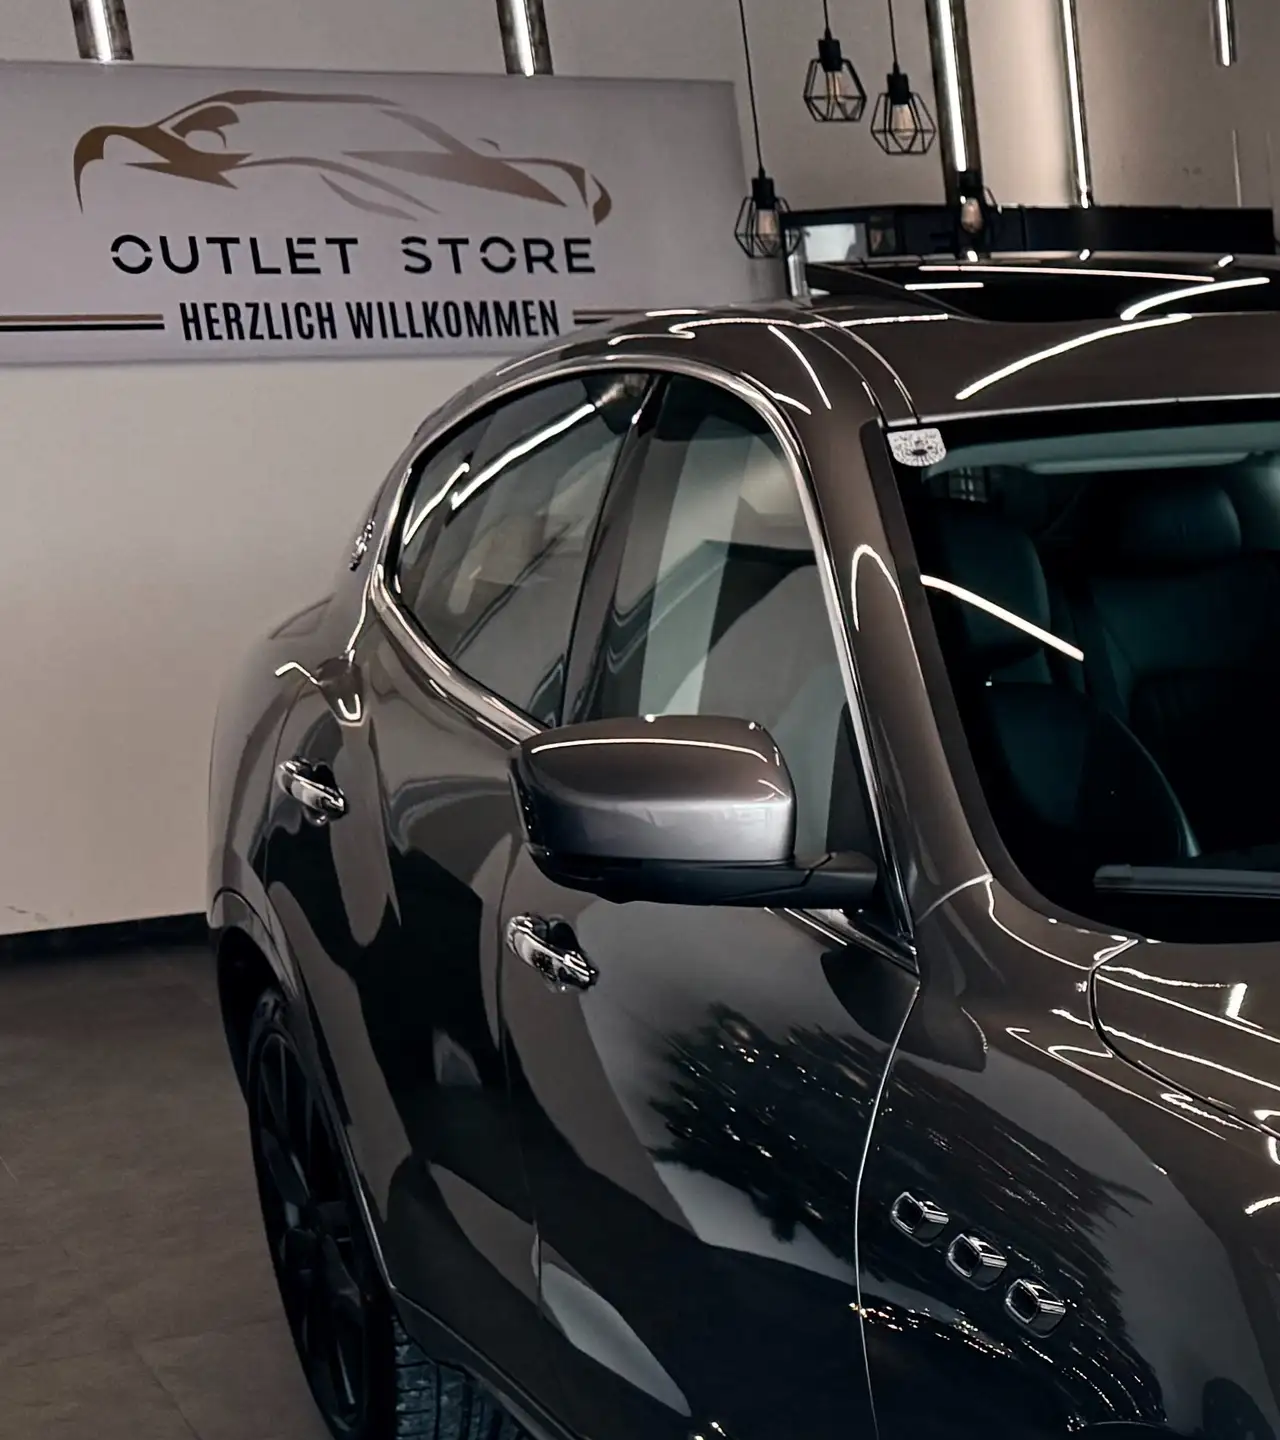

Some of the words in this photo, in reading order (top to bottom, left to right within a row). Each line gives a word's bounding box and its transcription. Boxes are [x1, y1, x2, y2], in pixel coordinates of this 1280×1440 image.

[110, 233, 360, 276] OUTLET
[401, 235, 597, 275] STORE
[179, 301, 338, 342] HERZLICH
[344, 299, 561, 341] WILLKOMMEN
